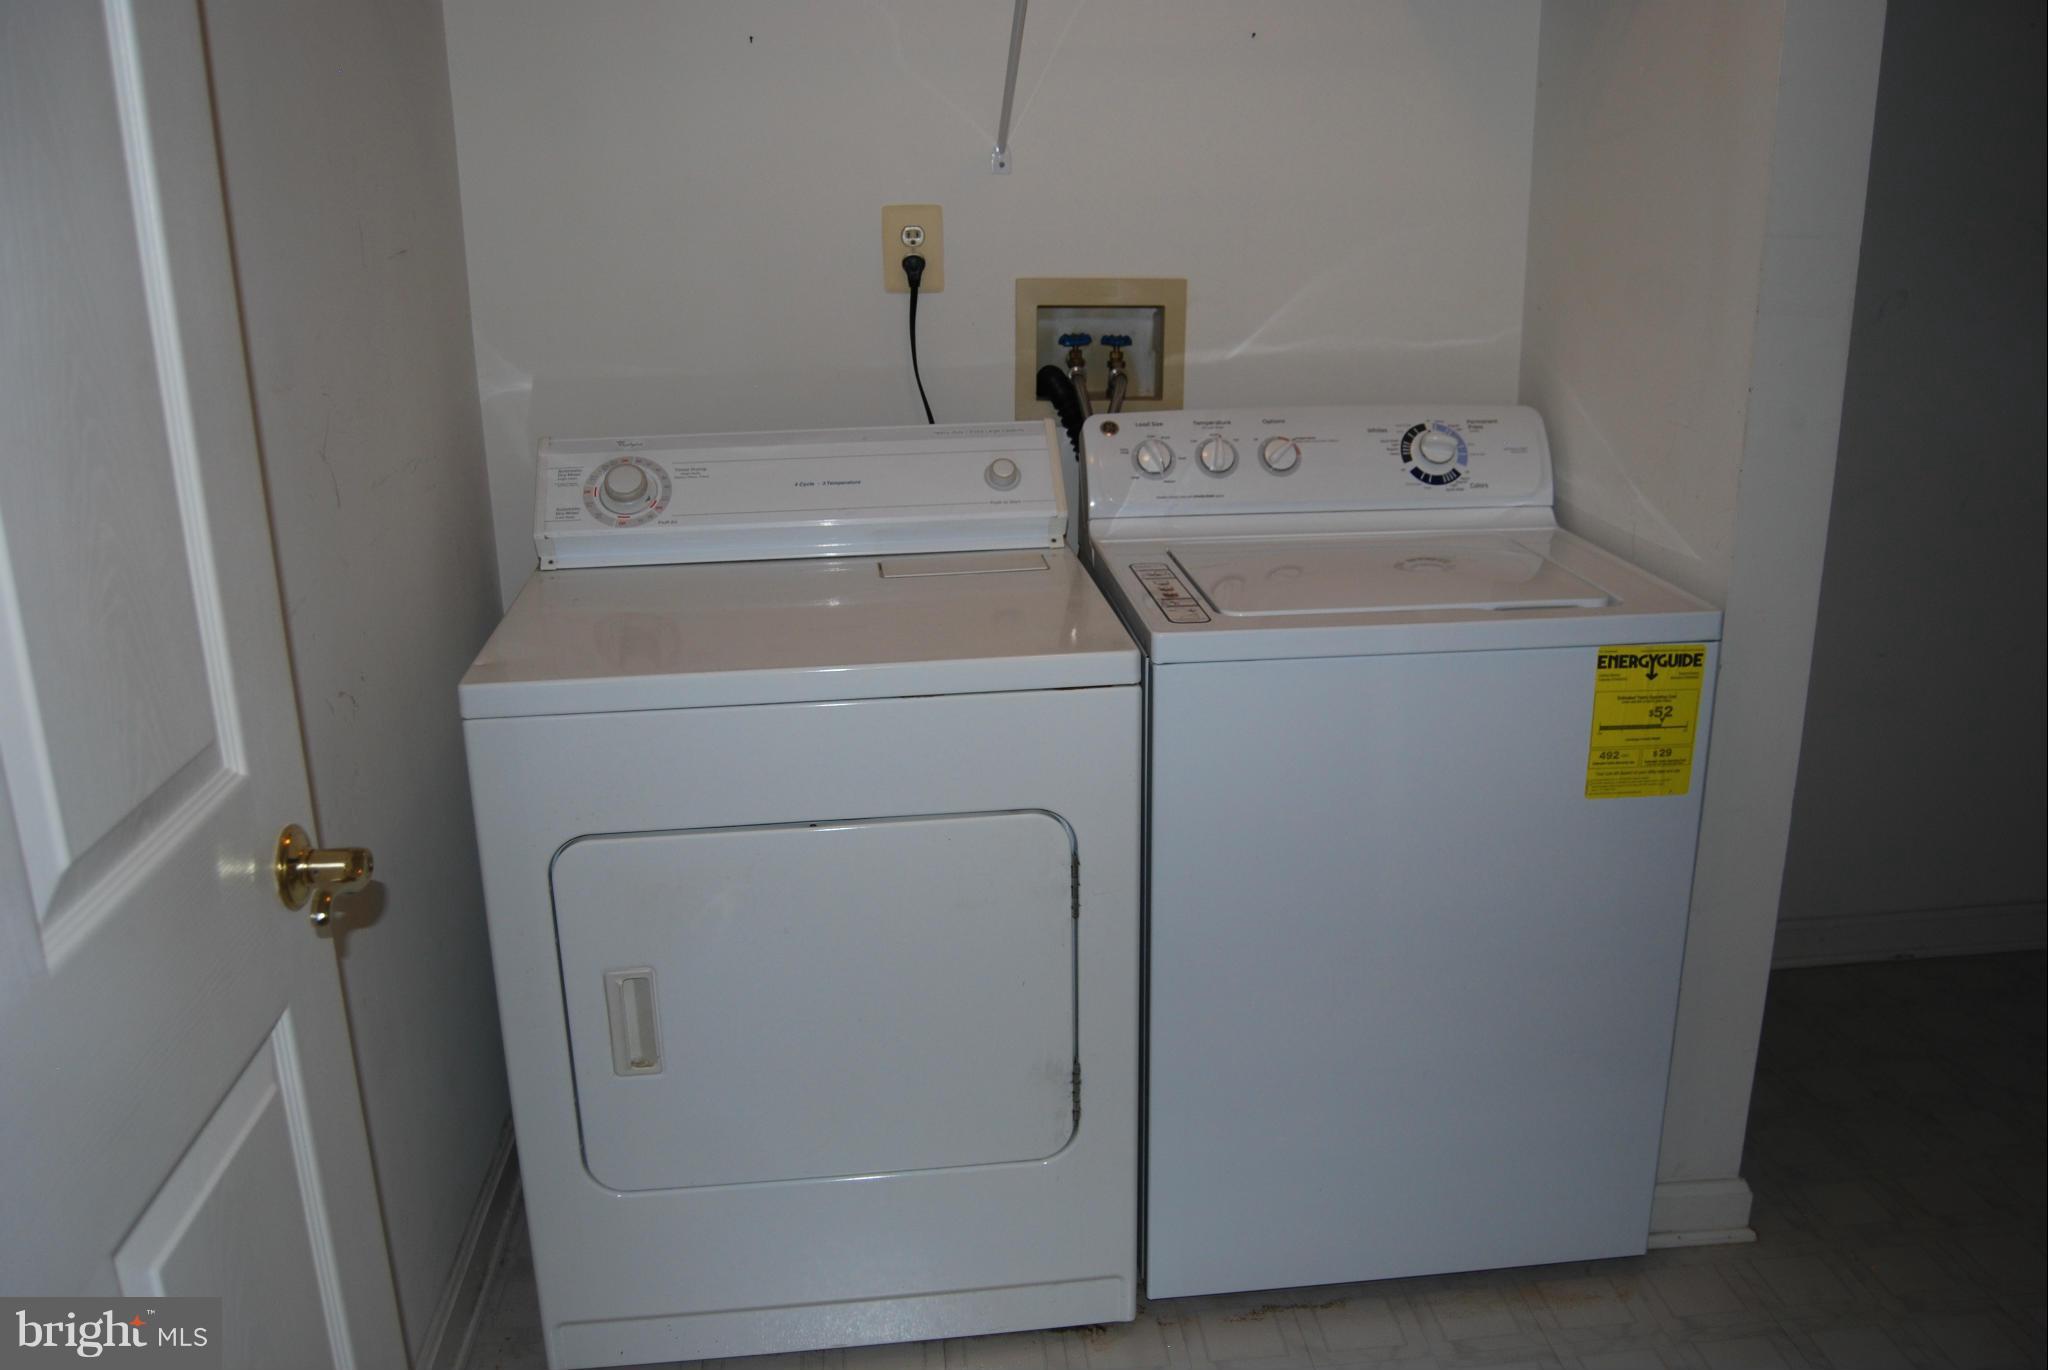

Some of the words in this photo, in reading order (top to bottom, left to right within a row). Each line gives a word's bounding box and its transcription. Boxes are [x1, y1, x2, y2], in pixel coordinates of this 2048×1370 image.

[1597, 652, 1704, 670] ENERGYGUIDE
[1648, 705, 1674, 719] $52
[1599, 750, 1620, 760] 492
